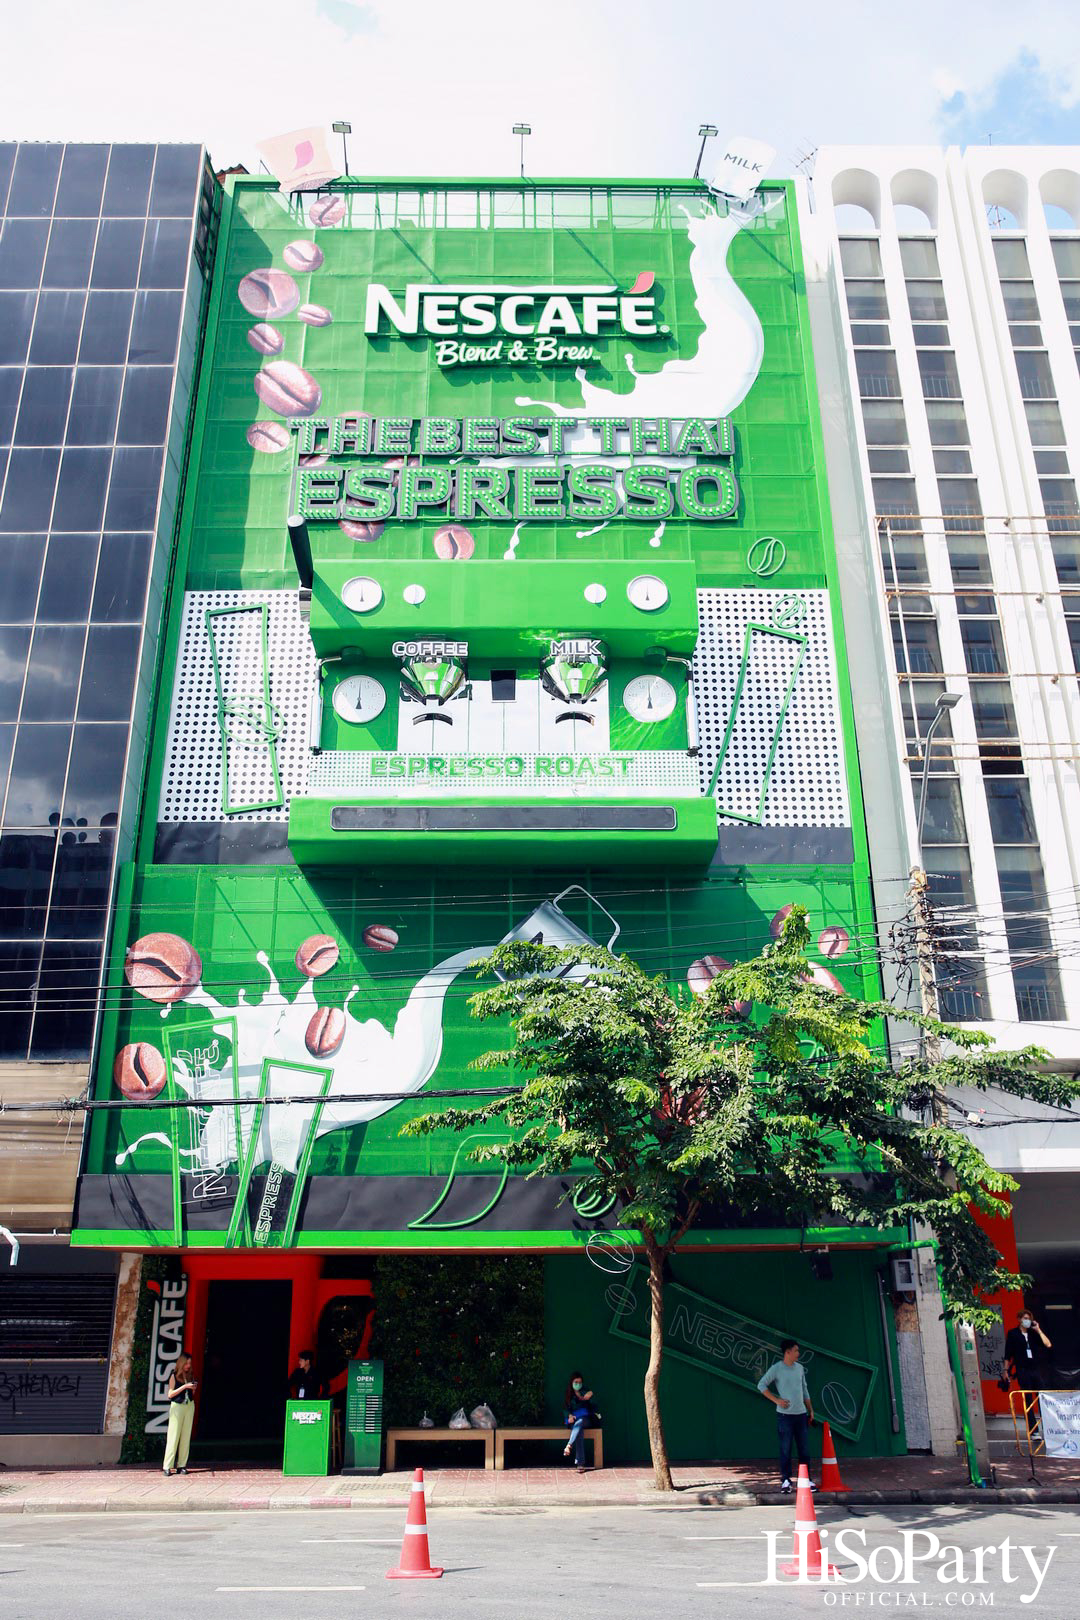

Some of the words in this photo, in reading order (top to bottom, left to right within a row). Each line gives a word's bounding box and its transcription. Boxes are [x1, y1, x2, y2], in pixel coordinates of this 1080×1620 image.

[724, 153, 763, 173] MILK
[435, 340, 503, 366] Blend
[508, 340, 528, 361] &
[534, 336, 594, 361] Brew
[288, 417, 412, 455] THE
[421, 417, 578, 455] BEST
[588, 417, 736, 455] THAI
[293, 465, 739, 521] ESPRESSO
[392, 641, 468, 657] COFFEE
[550, 640, 602, 656] MILK
[370, 756, 525, 777] ESPRESSO
[535, 756, 635, 777] ROAST
